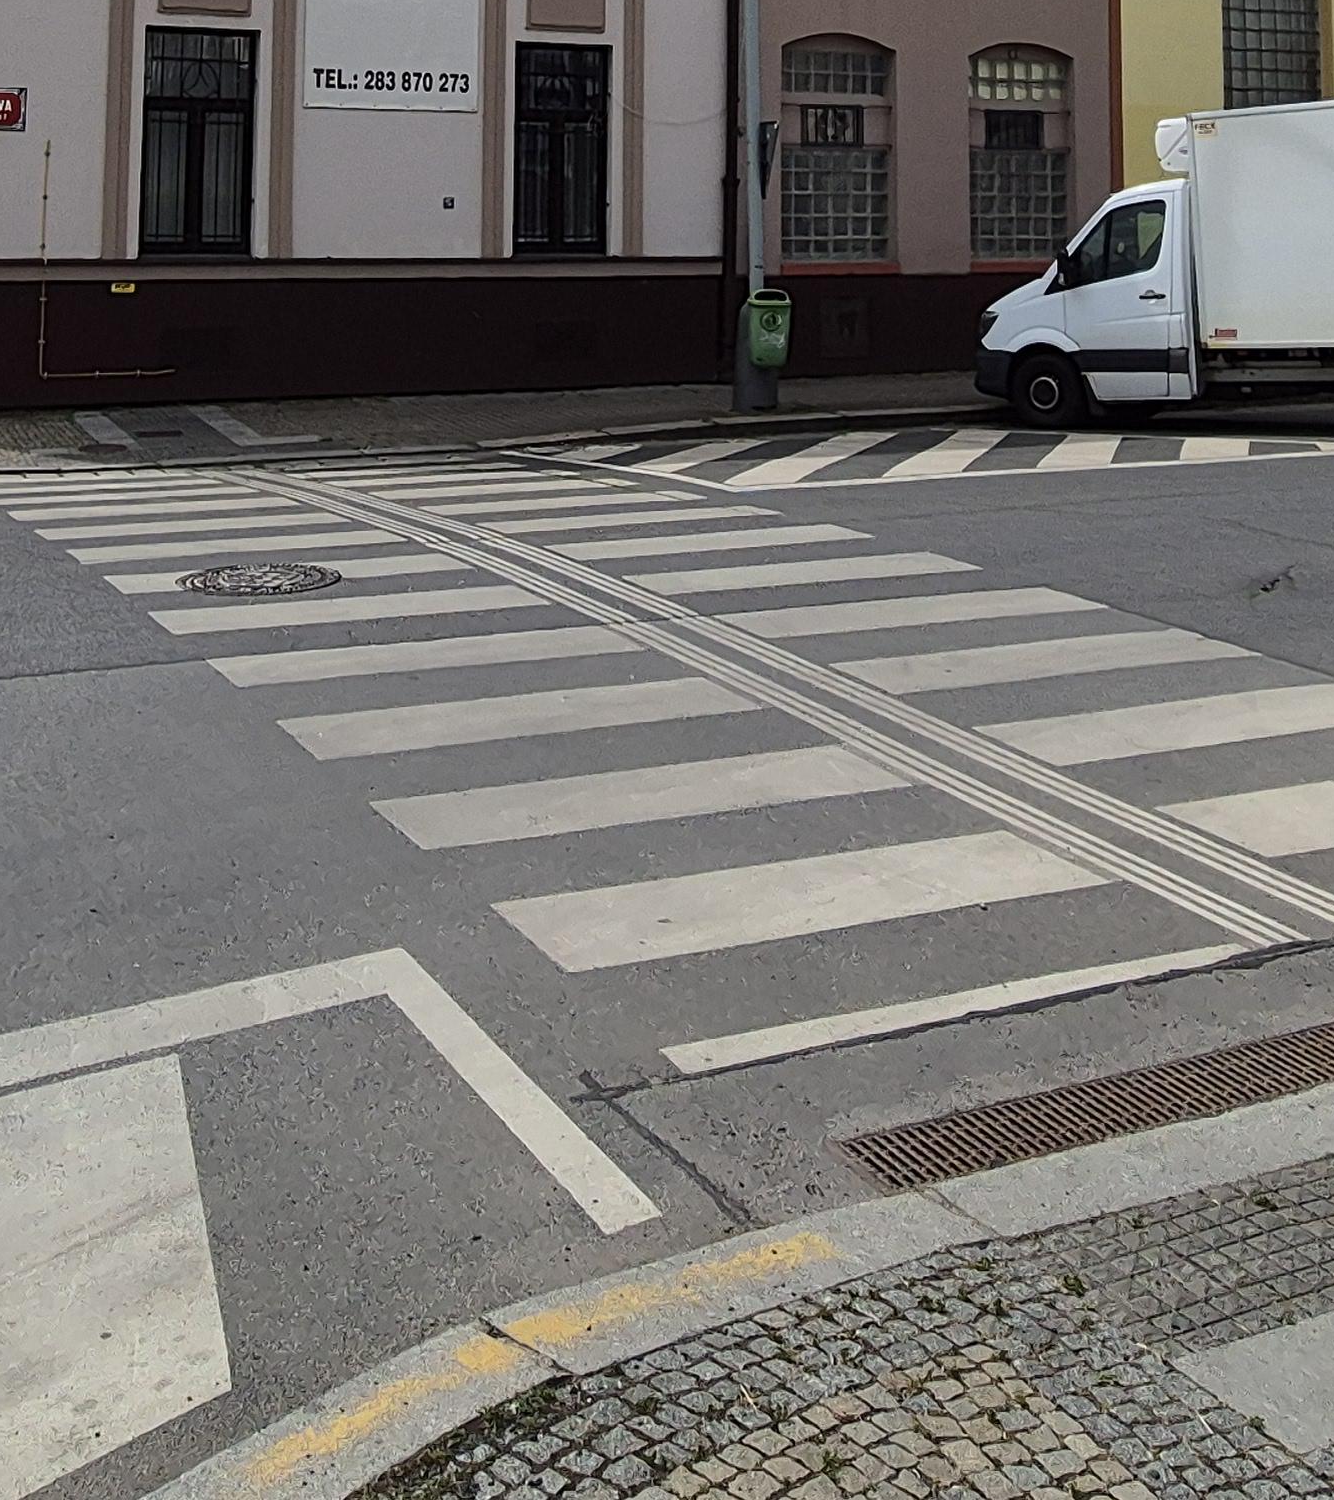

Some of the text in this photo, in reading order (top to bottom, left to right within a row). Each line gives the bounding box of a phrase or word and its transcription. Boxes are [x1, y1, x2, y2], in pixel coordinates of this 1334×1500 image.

[313, 67, 471, 95] TEL.: 283 870 273
